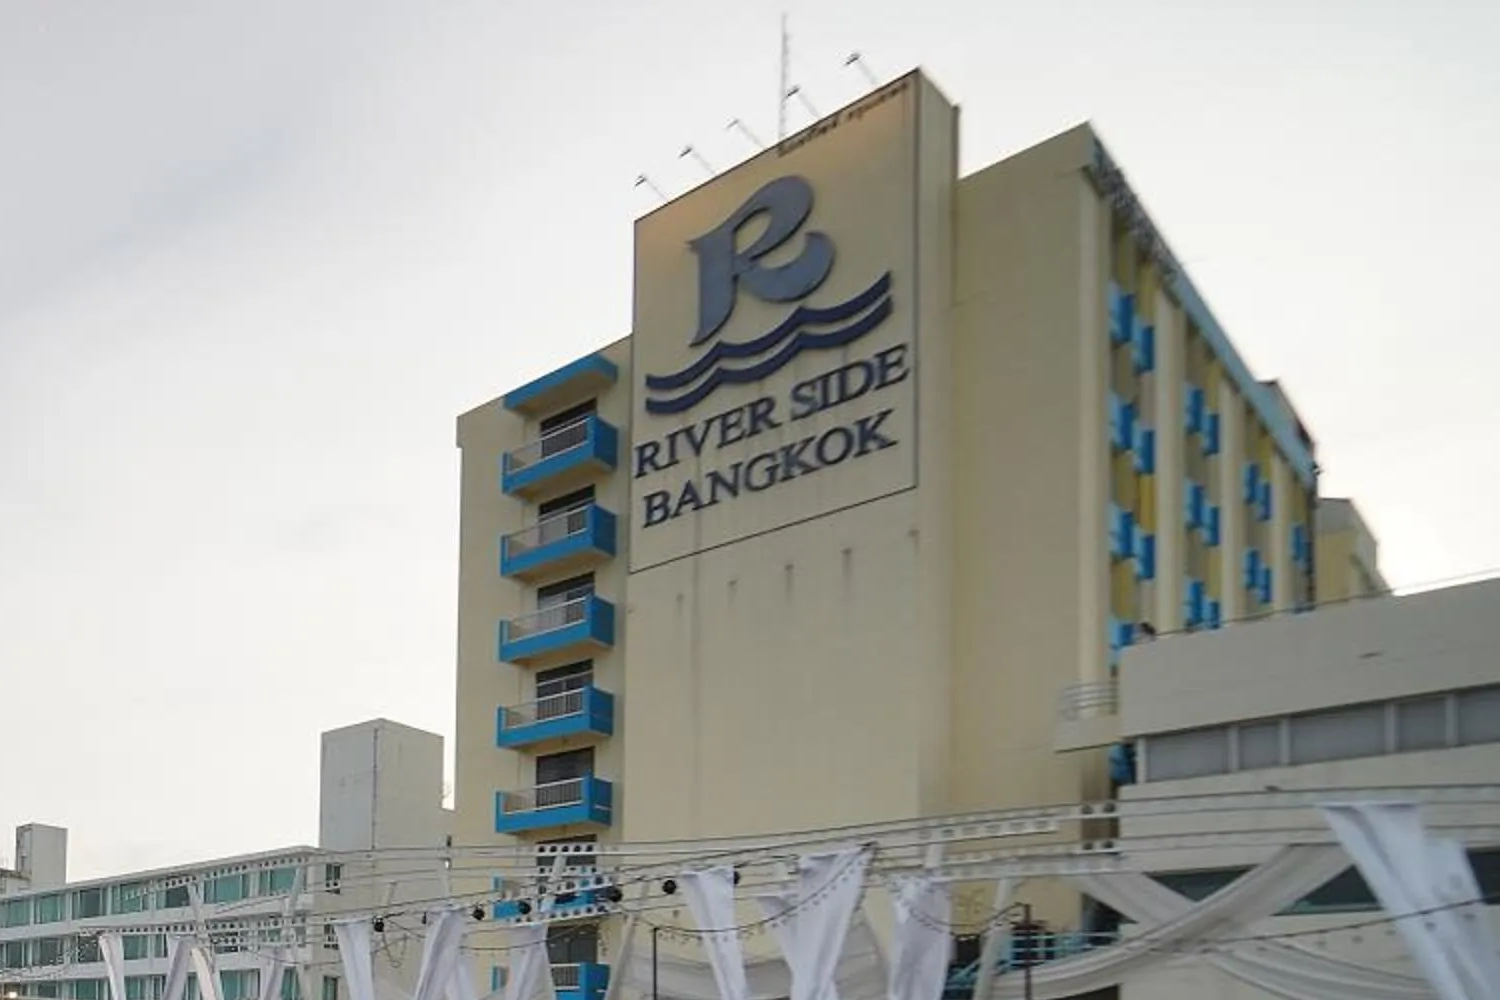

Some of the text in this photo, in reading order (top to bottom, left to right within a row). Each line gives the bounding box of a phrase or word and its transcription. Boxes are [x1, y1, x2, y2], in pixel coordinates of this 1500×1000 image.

[634, 343, 910, 479] RIVER SIDE
[642, 408, 899, 529] BANGKOK
